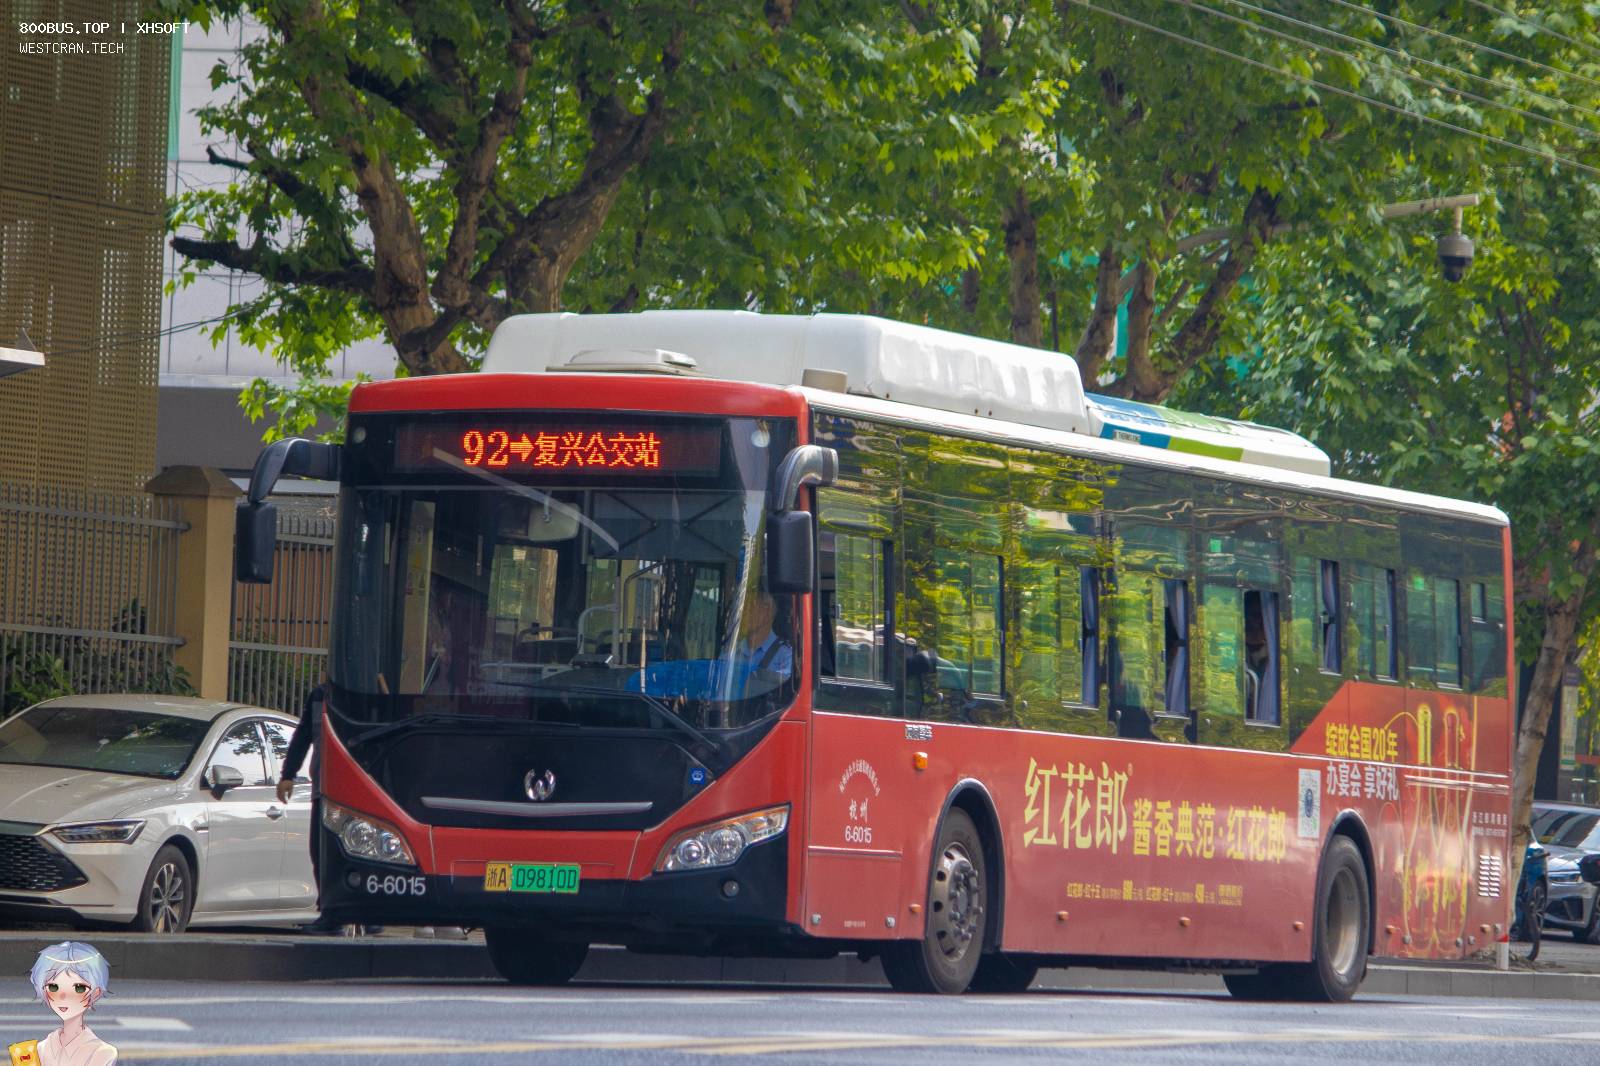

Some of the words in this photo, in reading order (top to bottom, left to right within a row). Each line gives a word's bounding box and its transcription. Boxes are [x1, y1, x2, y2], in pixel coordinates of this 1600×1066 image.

[463, 431, 509, 466] 92
[534, 431, 661, 467] 复兴公交站
[1325, 721, 1399, 763] 绽放全国20年
[1326, 760, 1362, 797] 办宴会
[1363, 764, 1399, 801] 享好礼
[1023, 756, 1129, 855] 红花郎
[844, 825, 872, 844] 6-6015
[1131, 798, 1287, 864] 酱香典范·红花郎
[366, 875, 426, 896] 6-6015
